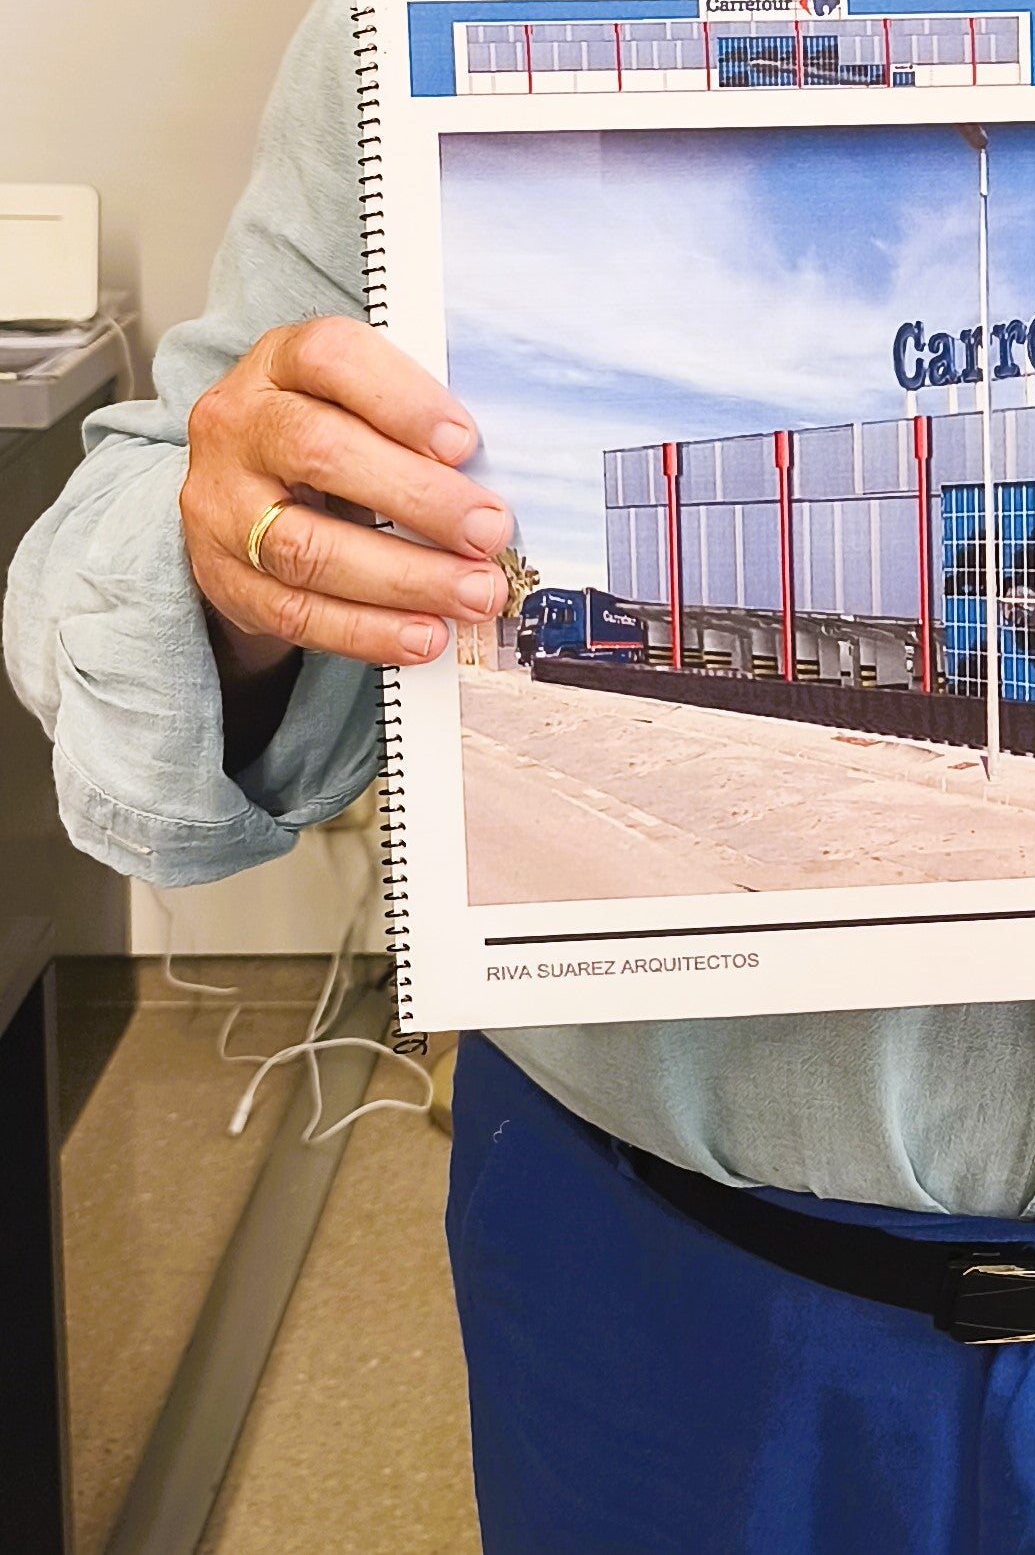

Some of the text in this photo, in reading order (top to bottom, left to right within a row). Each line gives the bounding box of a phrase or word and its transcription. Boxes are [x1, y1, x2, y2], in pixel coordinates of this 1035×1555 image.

[486, 952, 760, 982] RIVA SUAREZ ARQUITECTOS
